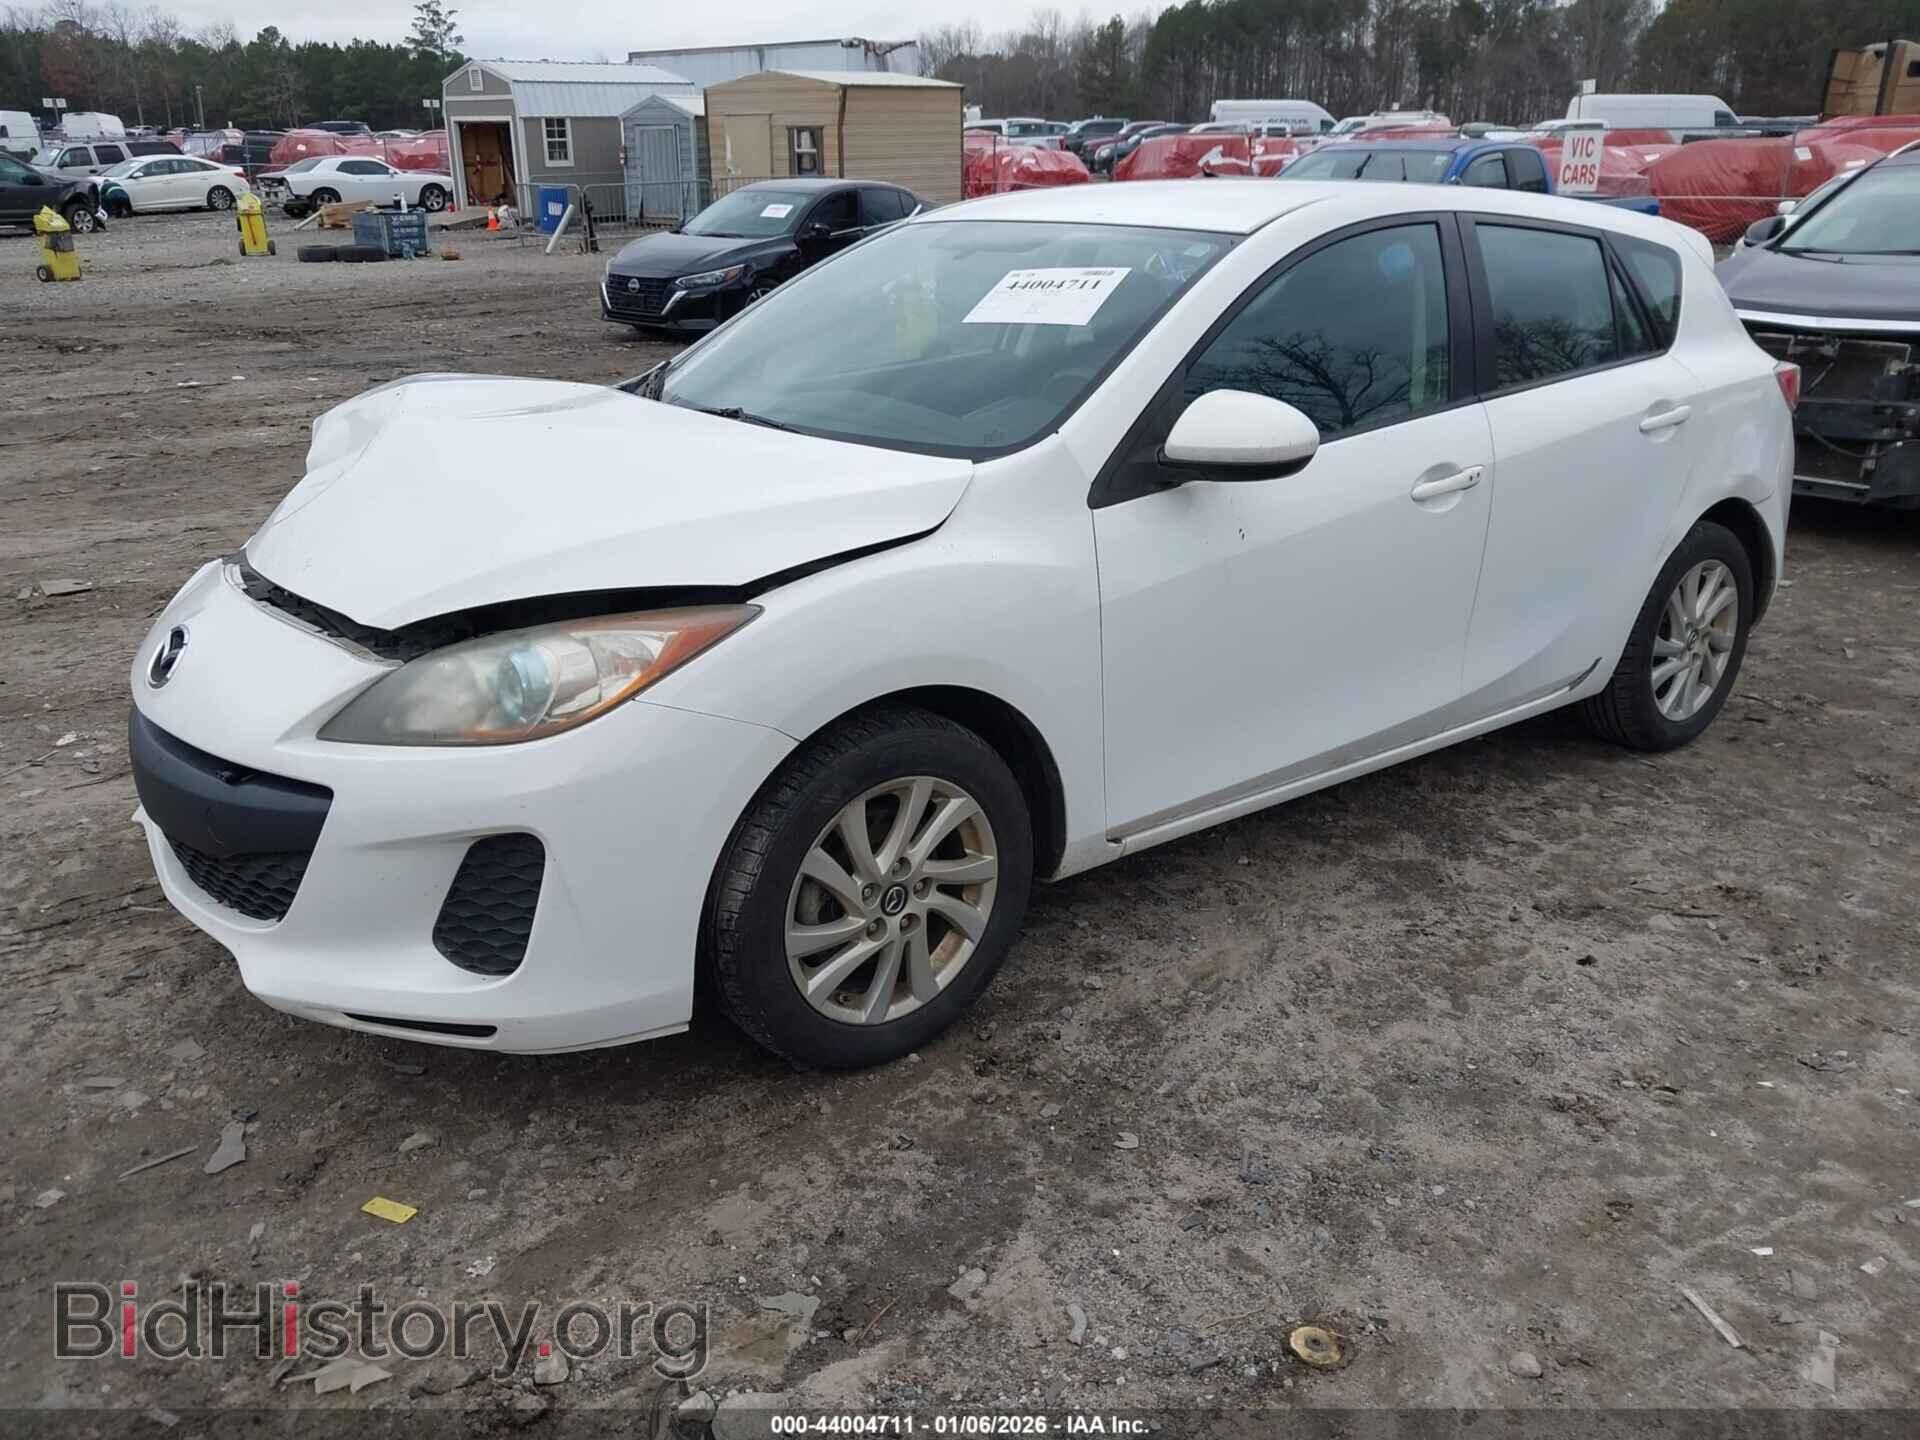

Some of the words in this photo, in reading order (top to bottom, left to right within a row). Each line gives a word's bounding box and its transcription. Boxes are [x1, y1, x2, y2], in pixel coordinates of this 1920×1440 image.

[1571, 137, 1596, 158] VIC
[1562, 164, 1597, 185] CARS
[1006, 279, 1102, 290] 44004711
